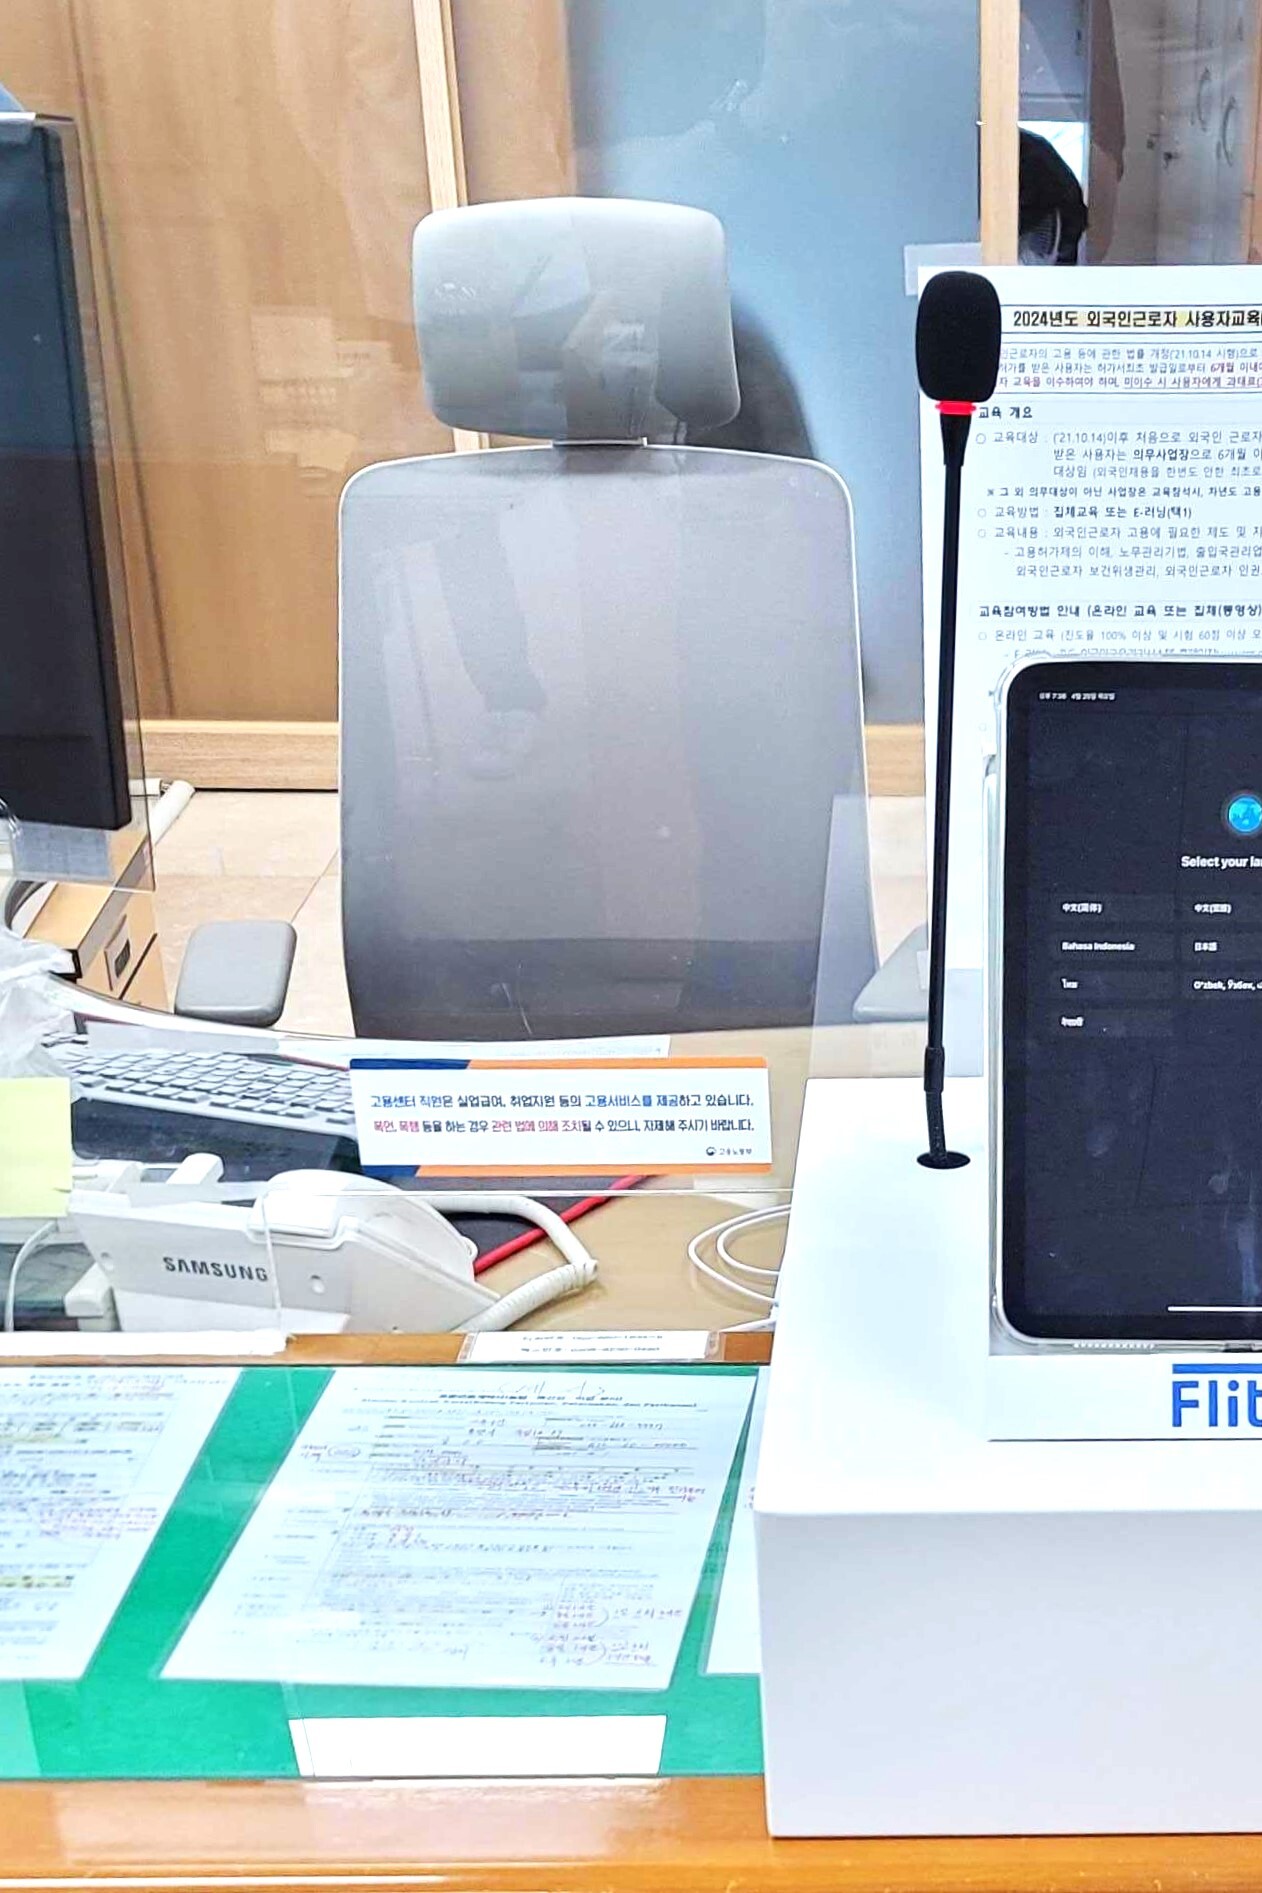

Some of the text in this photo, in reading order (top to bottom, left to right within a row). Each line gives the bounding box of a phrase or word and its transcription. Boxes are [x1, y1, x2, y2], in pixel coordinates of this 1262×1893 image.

[1013, 310, 1078, 327] 2024년도
[1087, 310, 1177, 328] 외국인근로자
[979, 407, 1033, 419] 교육 개요
[1057, 605, 1080, 617] 안내
[1134, 605, 1156, 617] 교육
[1164, 605, 1187, 617] 또는
[1181, 856, 1220, 868] Select
[1221, 858, 1249, 870] your
[371, 1095, 416, 1108] 고용센터
[419, 1095, 453, 1108] 직원은
[510, 1095, 555, 1108] 취업지원
[559, 1094, 581, 1107] 등의
[585, 1094, 653, 1107] 고용서비스를
[656, 1094, 701, 1107] 제공하고
[705, 1094, 754, 1107] 있습니다.
[445, 1120, 466, 1133] 하는
[468, 1120, 489, 1133] 경우
[595, 1120, 605, 1132] 수
[678, 1119, 708, 1132] 주시기
[710, 1119, 755, 1132] 바랍니다.
[163, 1256, 268, 1282] SAMSUNG
